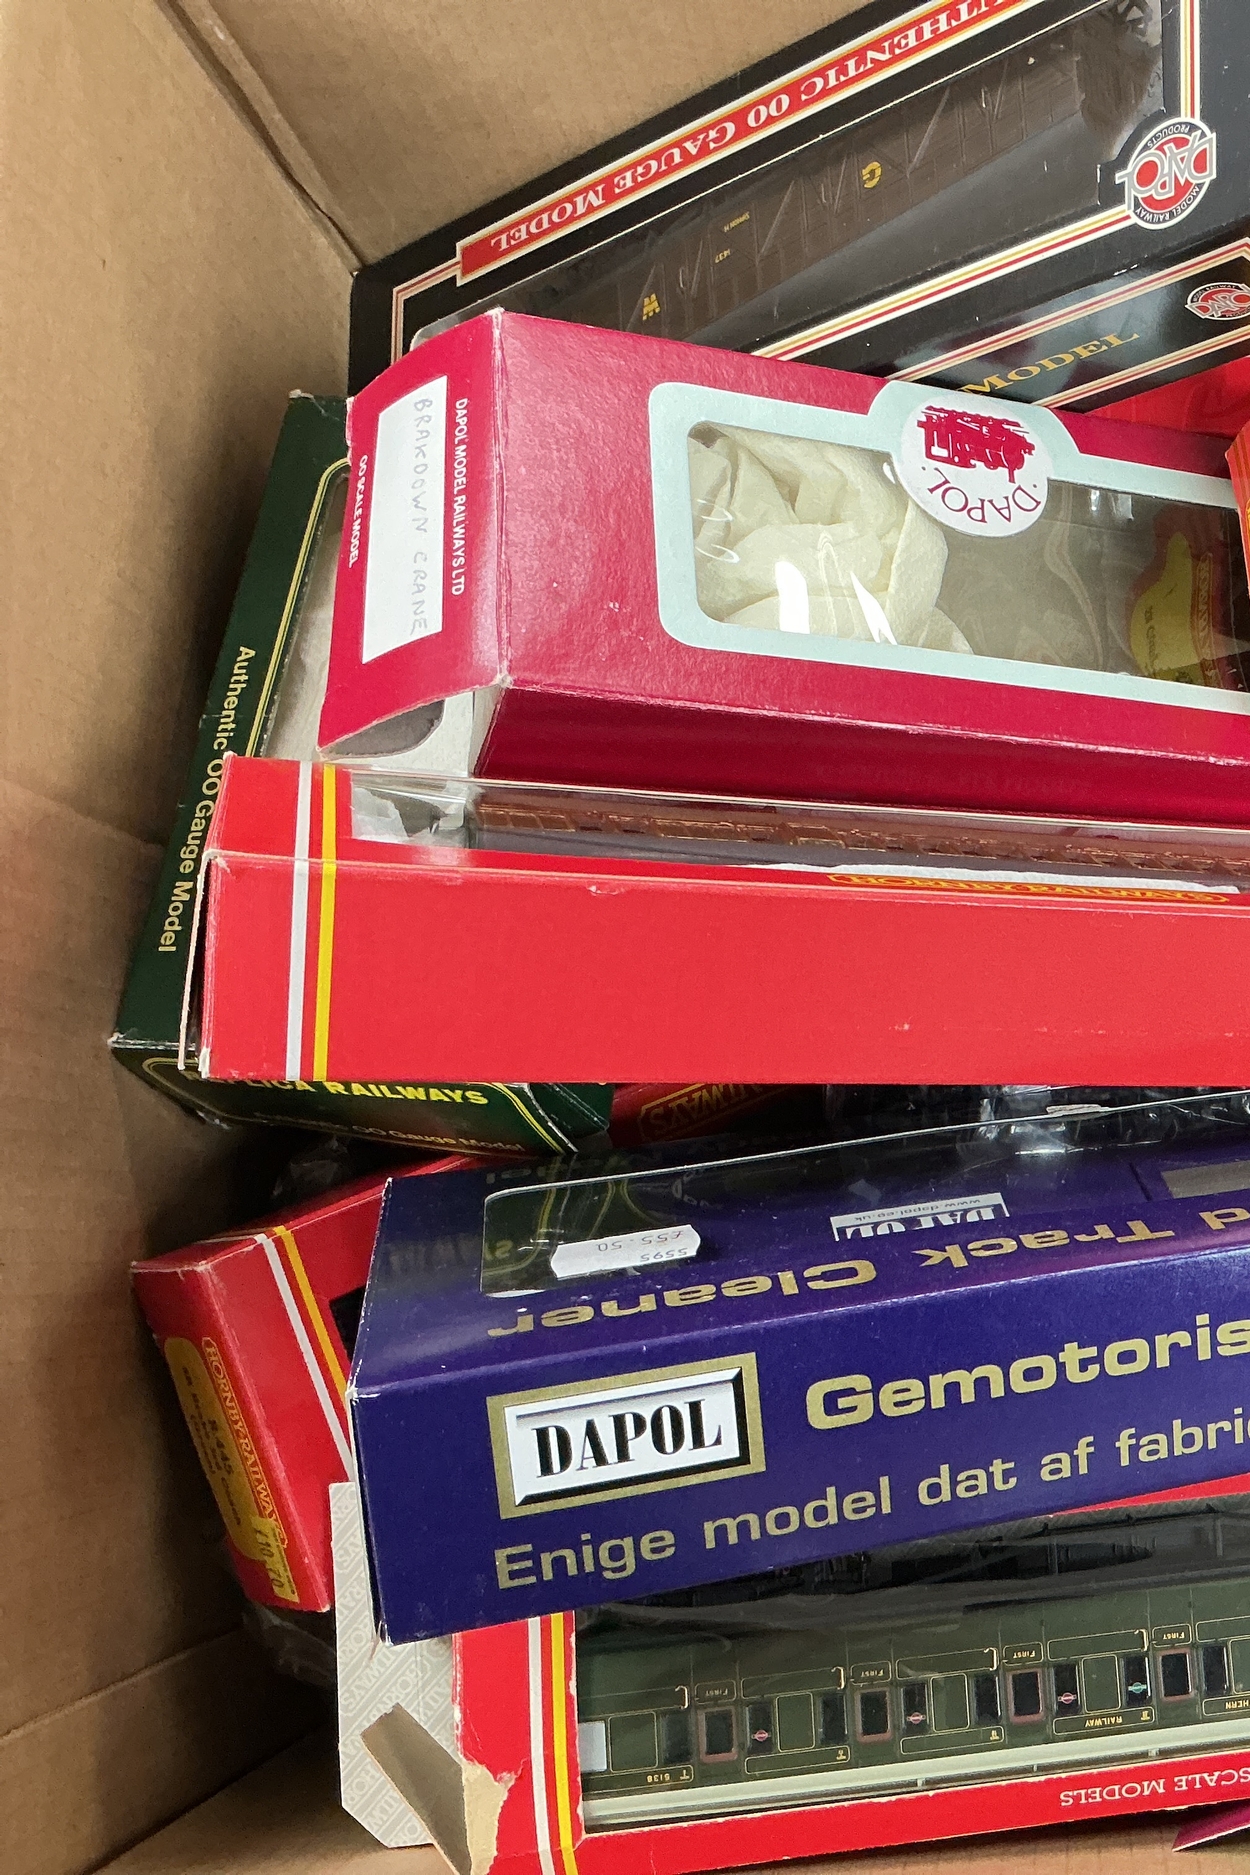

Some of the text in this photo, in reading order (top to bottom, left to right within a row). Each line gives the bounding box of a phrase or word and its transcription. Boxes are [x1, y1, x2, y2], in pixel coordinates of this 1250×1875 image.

[614, 120, 736, 194] GAUGE
[1147, 124, 1191, 149] PRODUCTS
[1115, 131, 1217, 211] DAPOL
[491, 183, 606, 252] MODEL
[1134, 185, 1200, 223] MODEL RAILWAY
[957, 331, 1140, 396] MODEL
[352, 476, 367, 517] SCALE
[451, 398, 468, 596] DAPOL MODEL RAILWAYS LTD
[925, 467, 1041, 524] DAPOL
[349, 516, 362, 569] MODEL
[410, 551, 428, 636] CRANE
[212, 645, 256, 751] Authentic
[179, 799, 216, 875] Gauge
[853, 875, 1013, 892] HORNBY
[157, 880, 195, 952] Model
[325, 1081, 489, 1105] RAILWAYS
[389, 1130, 457, 1145] Gauge
[458, 1137, 527, 1153] Model
[639, 1248, 688, 1263] 5595
[914, 1217, 1175, 1271] Track
[486, 1259, 877, 1338] Cleaner
[206, 1345, 246, 1436] HORNBY
[531, 1398, 723, 1479] DAPOL
[495, 1529, 677, 1590] Enige
[703, 1475, 893, 1550] model
[917, 1455, 1018, 1508] dat
[1038, 1435, 1097, 1483] af
[1012, 1649, 1037, 1660] FIRST
[1162, 1631, 1187, 1642] FIRST
[859, 1667, 885, 1679] FIRST
[1085, 1715, 1122, 1728] RAILWAY
[1060, 1779, 1165, 1808] MODELS
